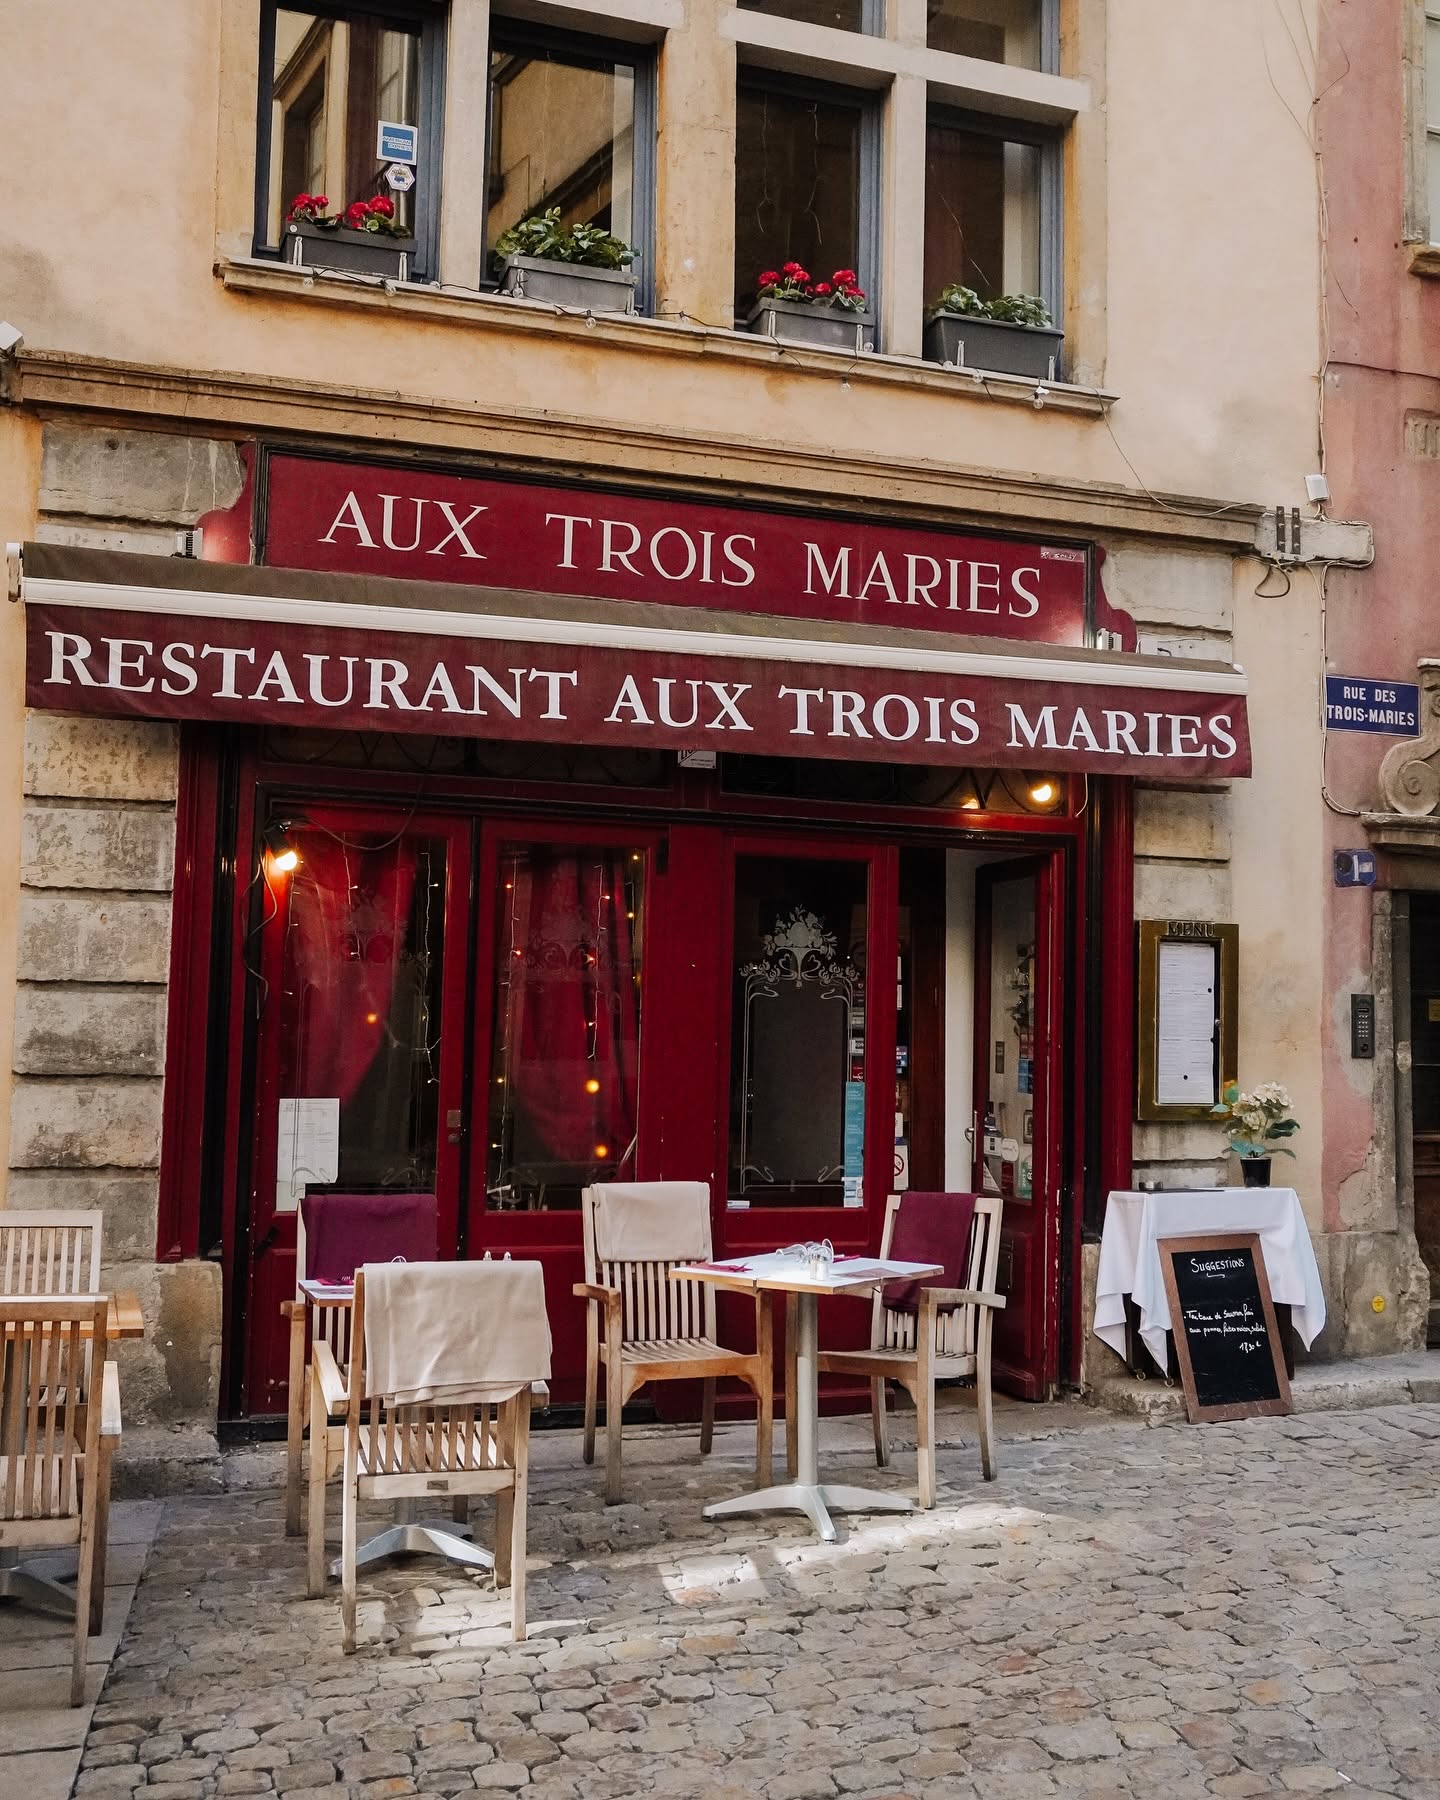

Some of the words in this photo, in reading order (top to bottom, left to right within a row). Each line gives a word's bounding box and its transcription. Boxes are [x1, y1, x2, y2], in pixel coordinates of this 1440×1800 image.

[318, 490, 489, 560] AUX
[546, 513, 757, 587] TROIS
[803, 541, 1041, 619] MARIES
[44, 631, 578, 720] RESTAURANT
[604, 675, 754, 731] AUX
[778, 685, 979, 745] TROIS
[1005, 703, 1237, 759] MARIES
[1343, 686, 1367, 701] RUE
[1375, 688, 1396, 703] DES
[1168, 921, 1216, 937] MENU
